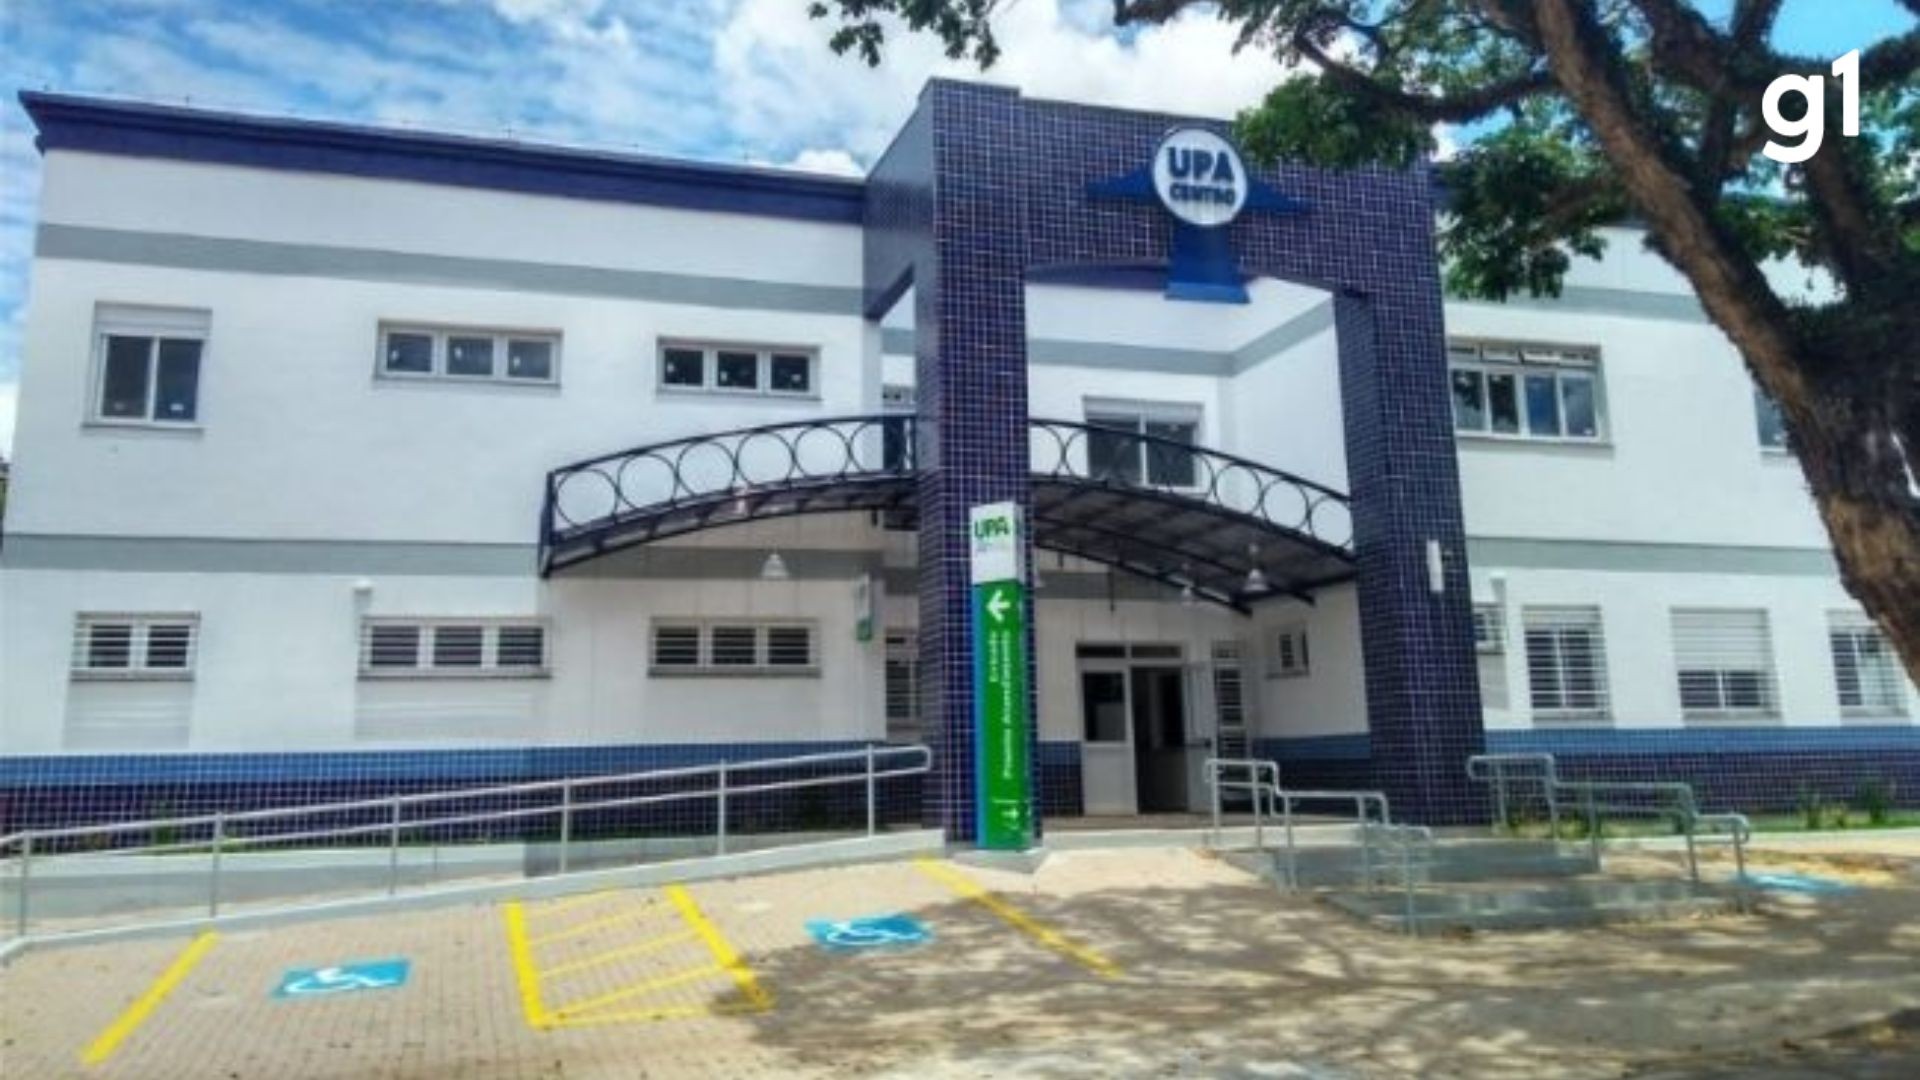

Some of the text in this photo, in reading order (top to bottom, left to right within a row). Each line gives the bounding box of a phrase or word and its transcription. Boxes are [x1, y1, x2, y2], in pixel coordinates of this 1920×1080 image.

[1167, 146, 1236, 182] UPA
[1169, 182, 1236, 207] CENTRO
[974, 516, 1010, 539] UPA
